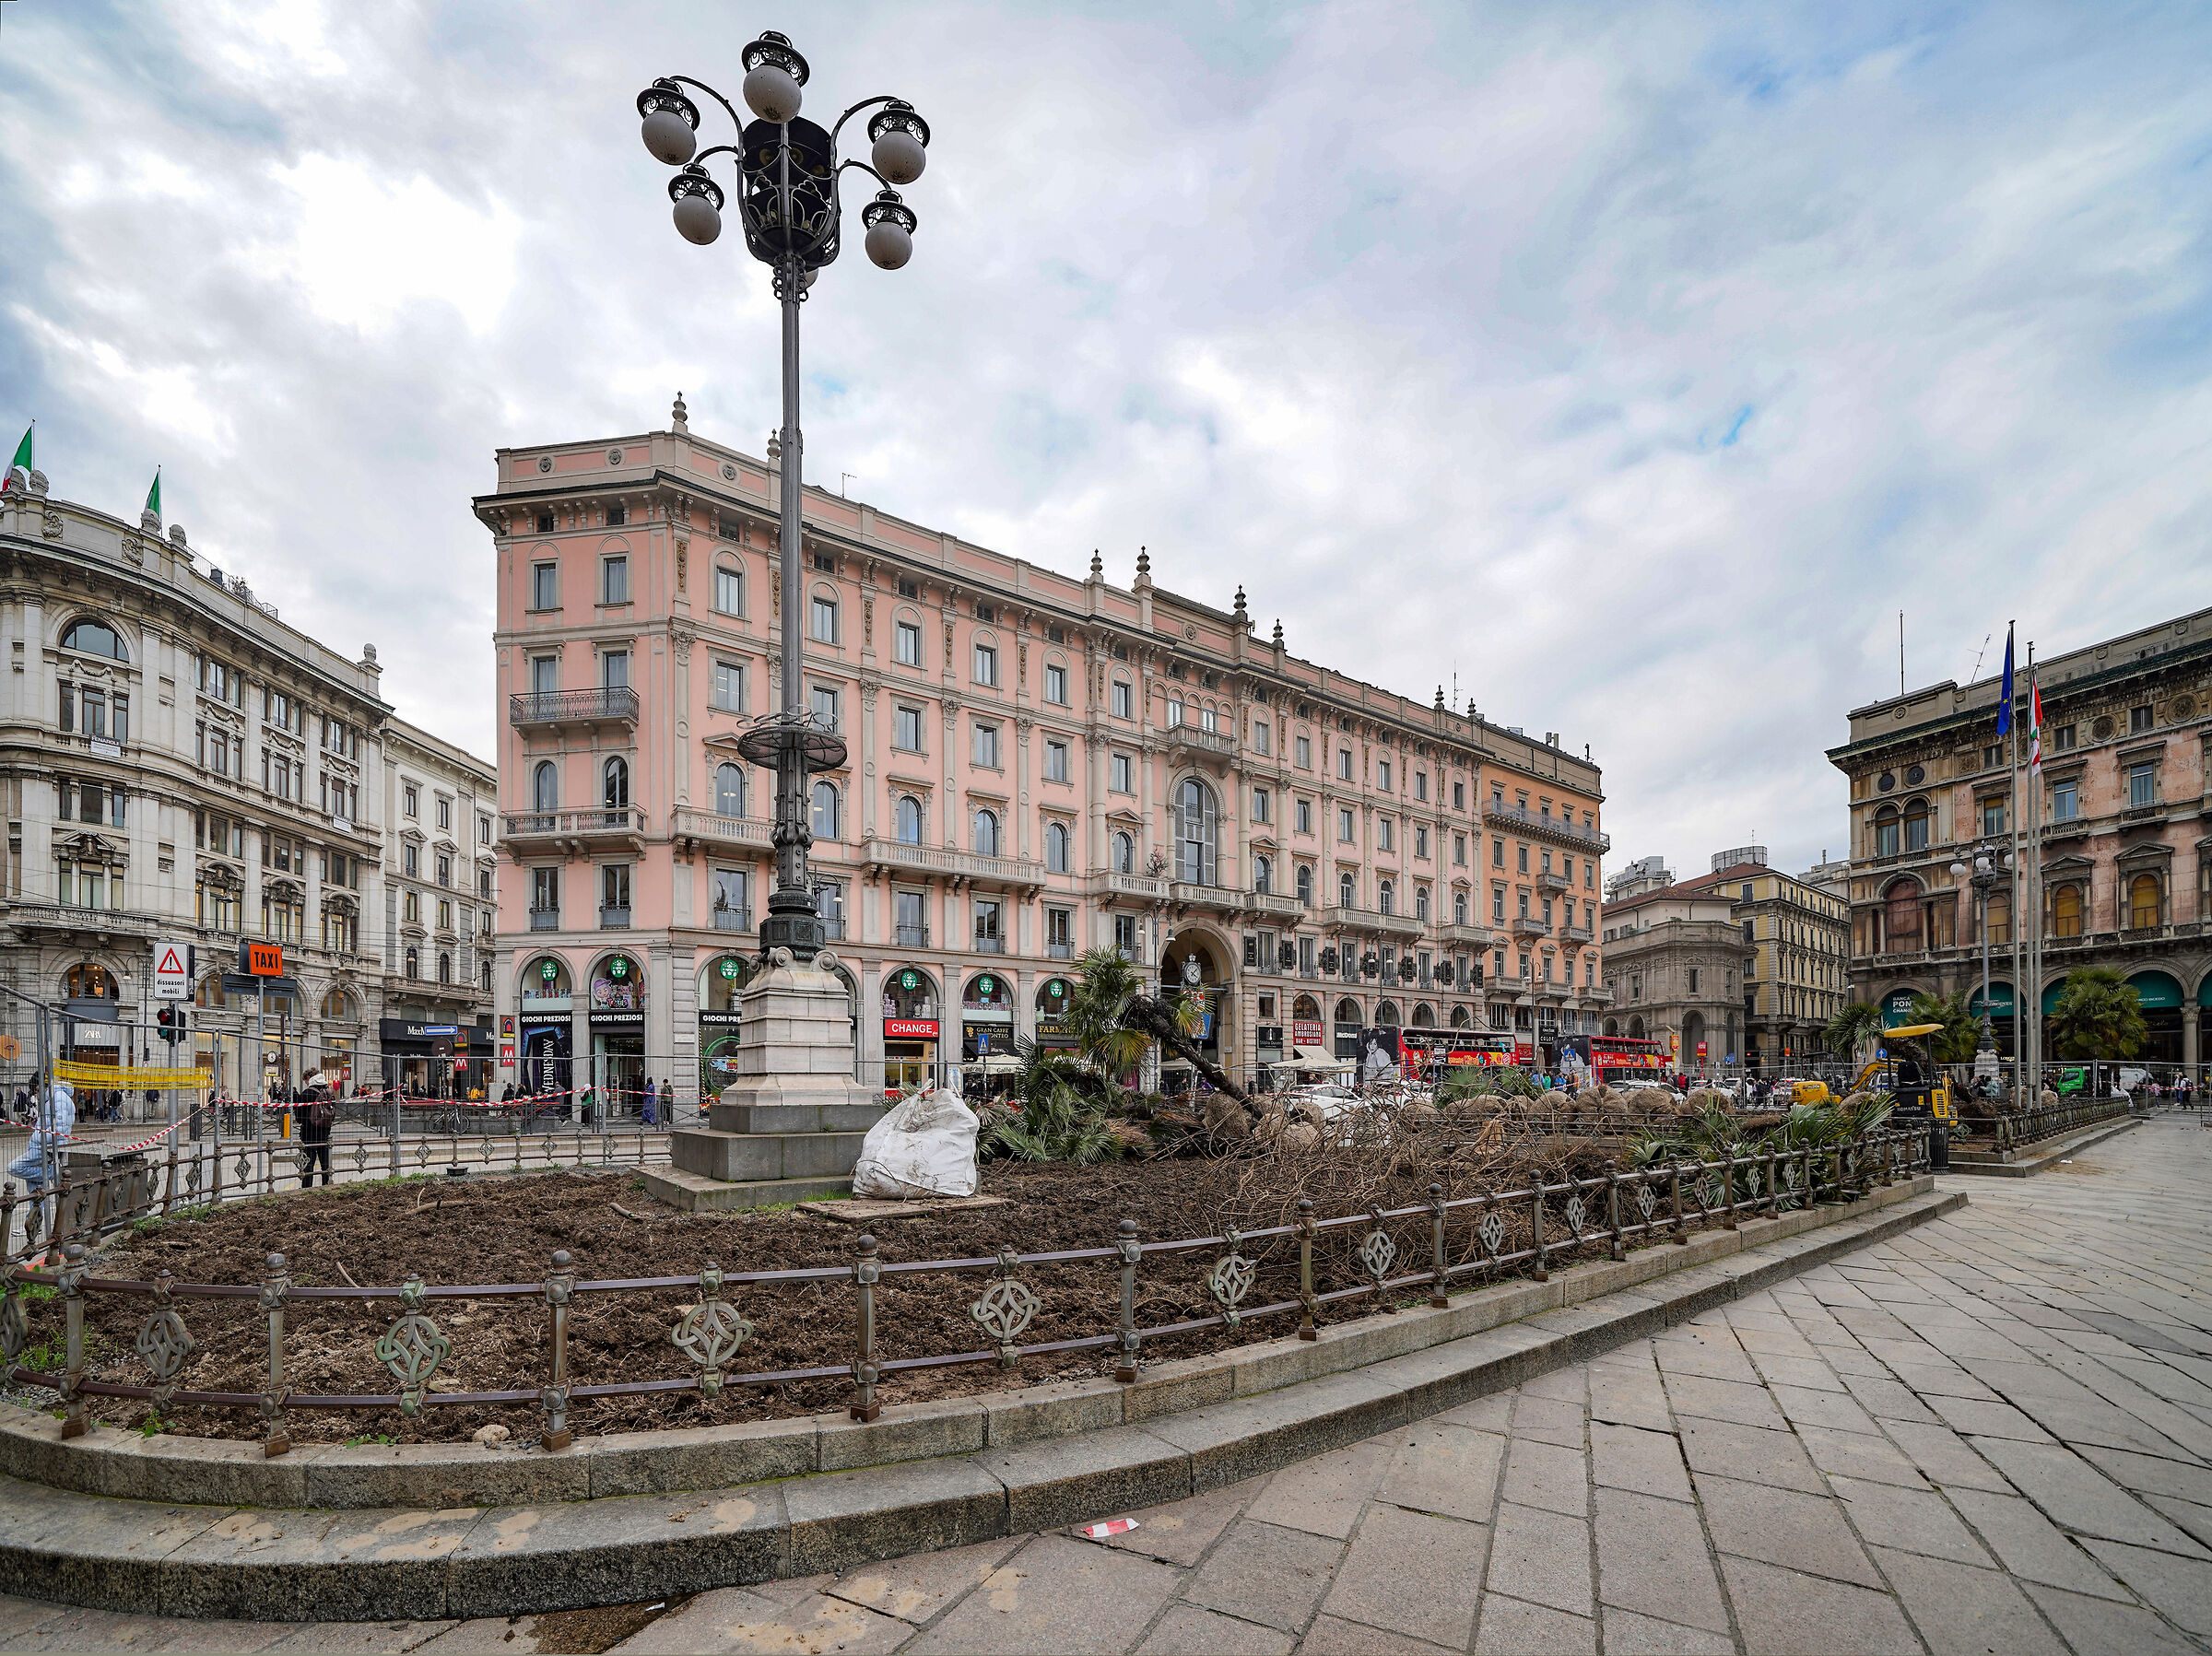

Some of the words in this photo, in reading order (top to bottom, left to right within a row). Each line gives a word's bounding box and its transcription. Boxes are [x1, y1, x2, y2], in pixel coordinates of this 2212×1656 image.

[253, 951, 278, 969] TAXI
[891, 1023, 933, 1033] CHANGE
[1294, 1023, 1322, 1031] GELATERIA
[85, 1029, 101, 1039] ZARA
